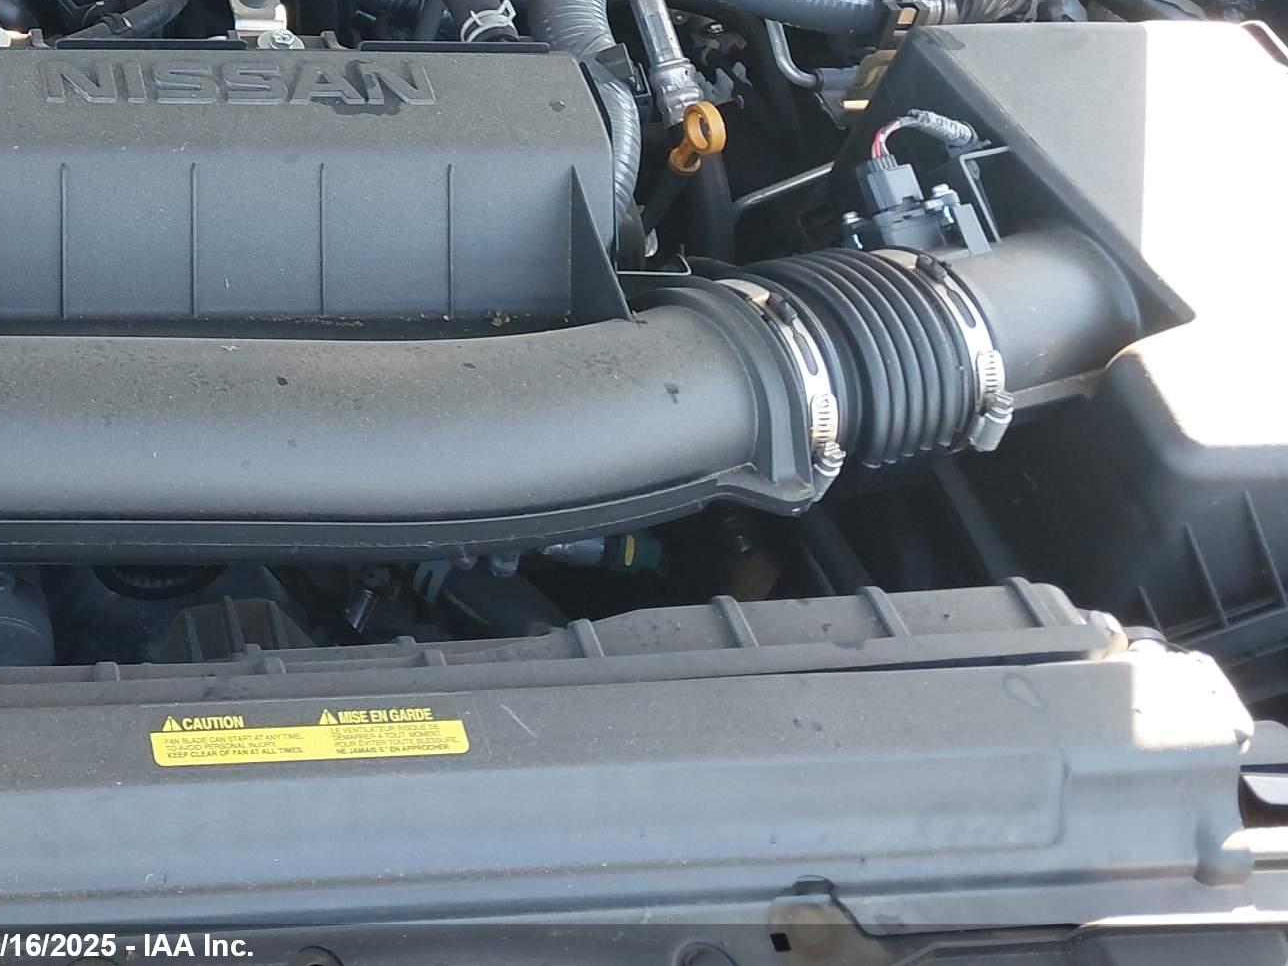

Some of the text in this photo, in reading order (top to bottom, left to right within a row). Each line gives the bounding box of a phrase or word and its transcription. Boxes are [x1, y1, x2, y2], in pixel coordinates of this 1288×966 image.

[43, 59, 437, 105] NISSAN
[182, 707, 434, 731] CAUTION MISE EN GARDE
[167, 751, 189, 759] KEEP
[219, 749, 230, 757] OF
[350, 746, 377, 754] JAMAIS
[390, 745, 401, 753] EN
